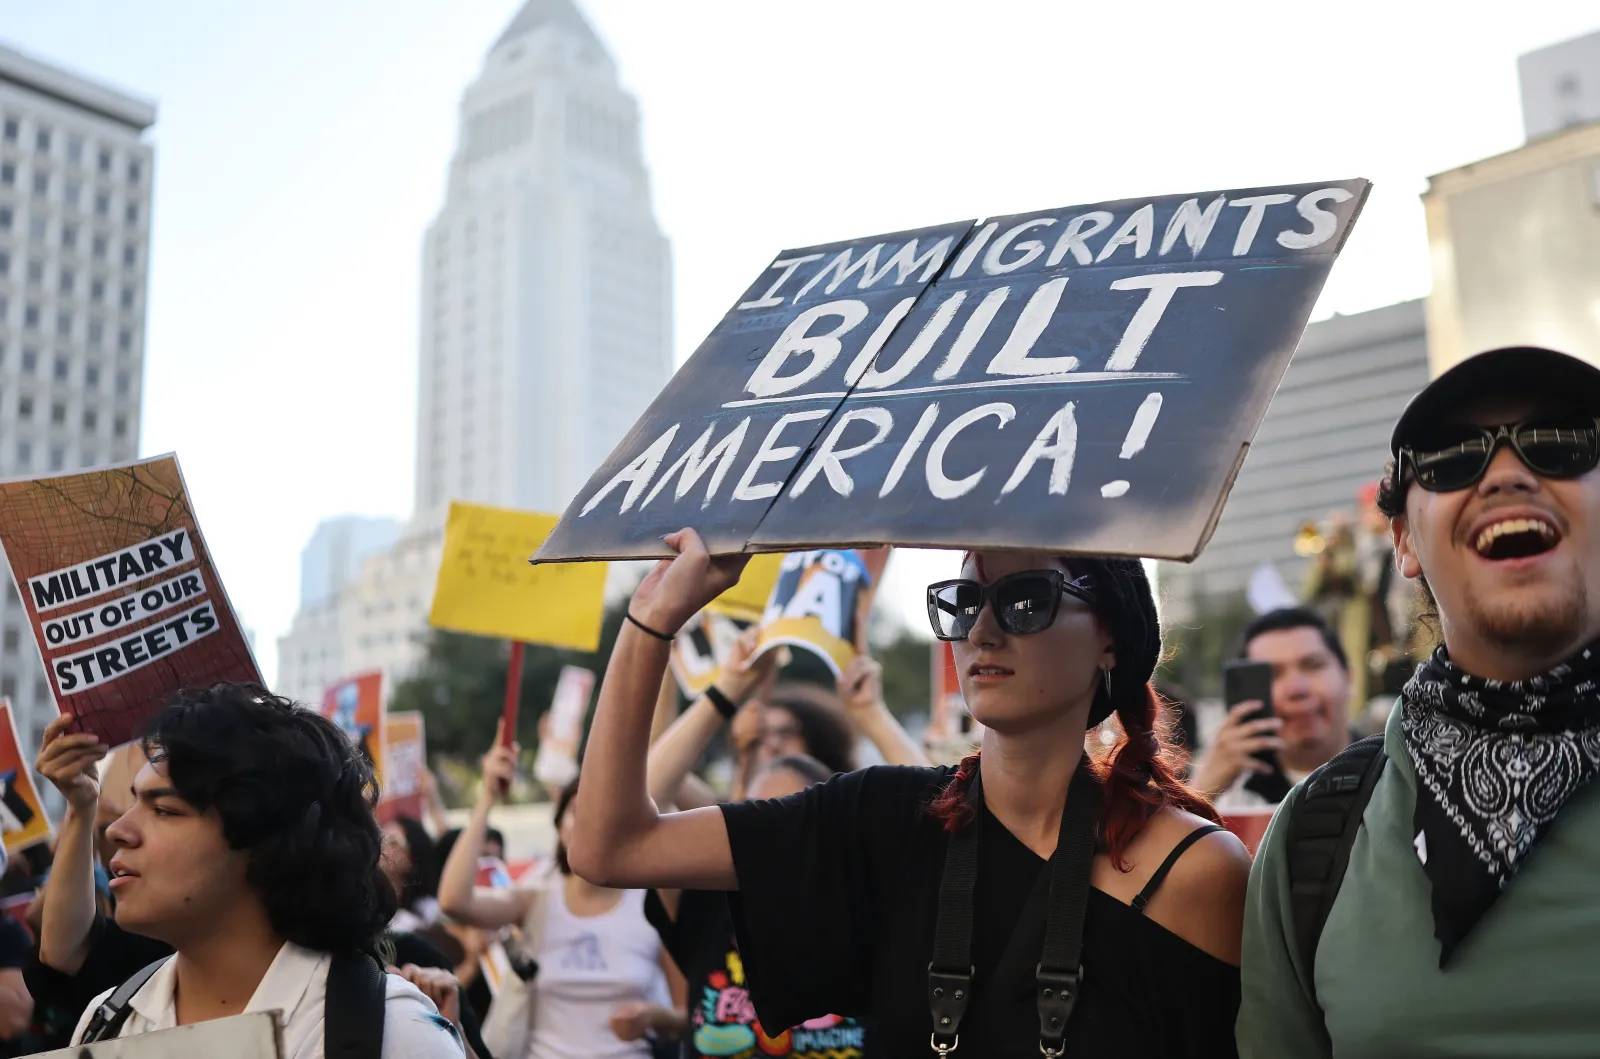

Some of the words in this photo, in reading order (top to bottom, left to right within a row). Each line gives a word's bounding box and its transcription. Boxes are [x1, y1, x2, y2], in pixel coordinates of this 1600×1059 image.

[737, 187, 1353, 310] IMMIGRANTS
[744, 270, 1224, 398] BUILT
[579, 392, 1163, 518] AMERICA!
[31, 531, 186, 608] MILITARY
[45, 613, 95, 645] OUT
[99, 599, 136, 628] OF
[140, 575, 202, 611] OUR
[56, 606, 216, 690] STREETS
